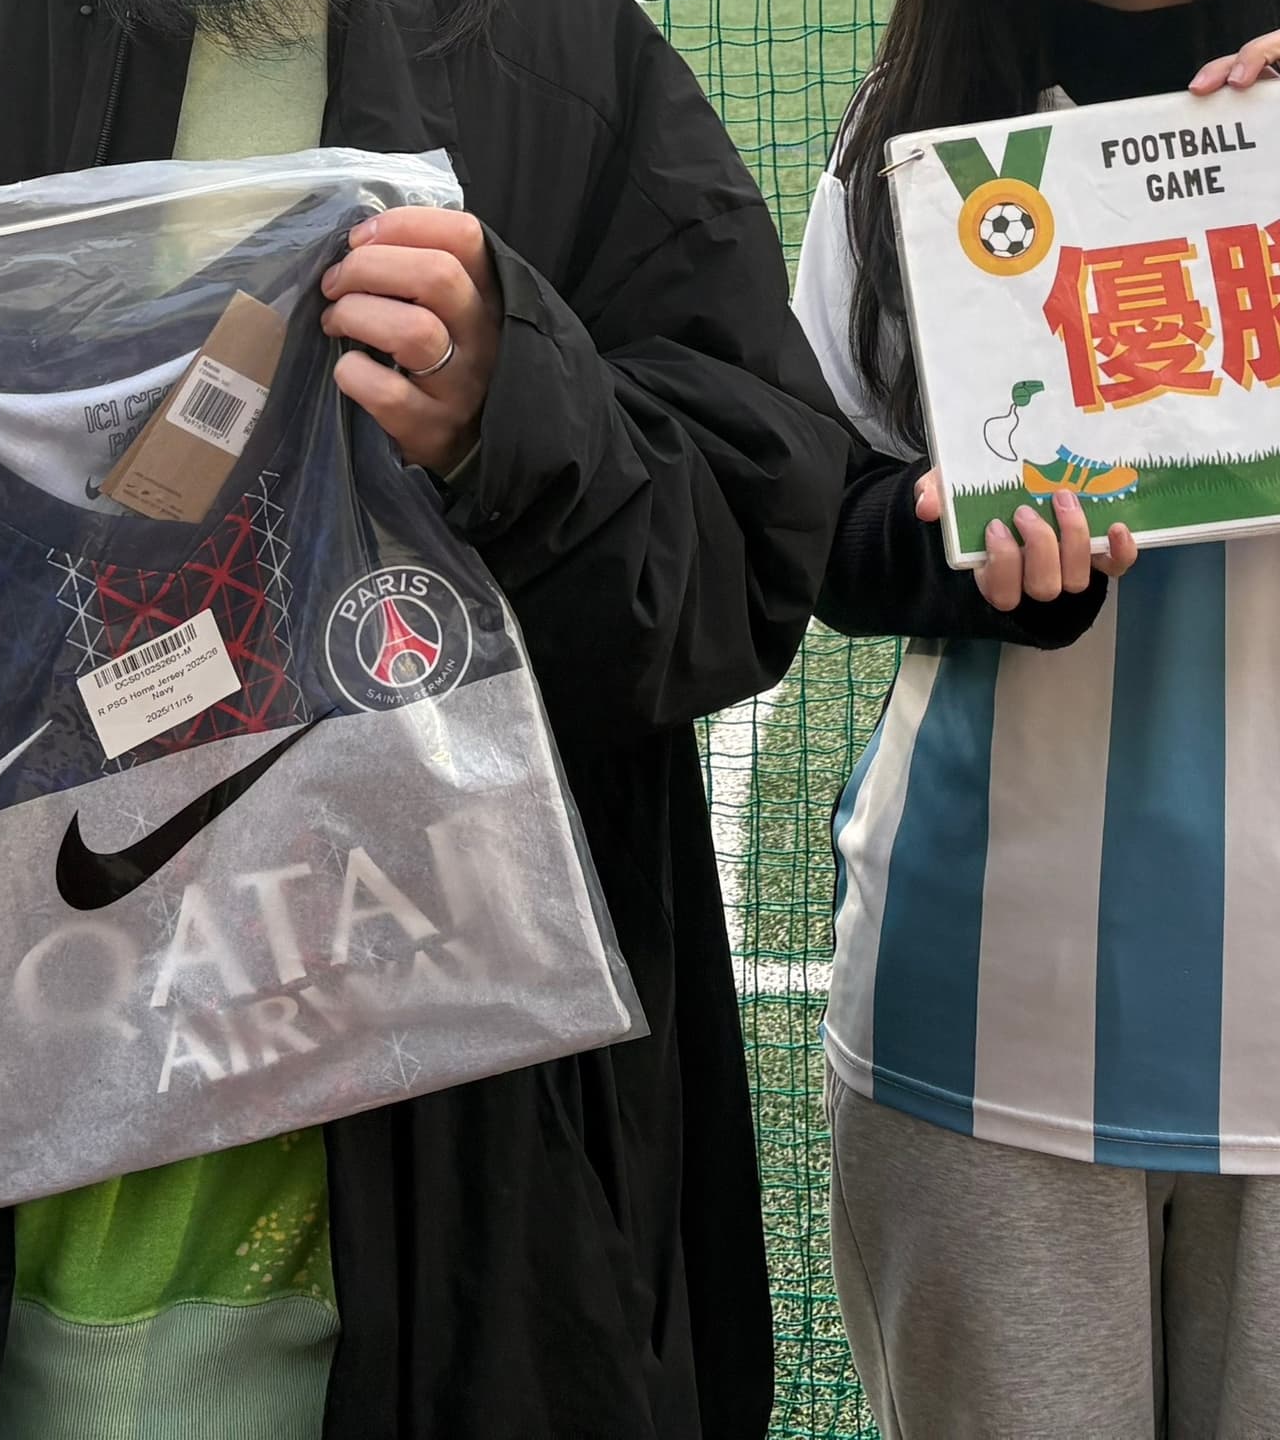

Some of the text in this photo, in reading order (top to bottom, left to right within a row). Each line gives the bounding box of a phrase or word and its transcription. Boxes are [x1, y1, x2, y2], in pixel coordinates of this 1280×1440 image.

[1101, 122, 1256, 168] FOOTBALL
[1146, 165, 1225, 202] GAME
[339, 573, 430, 622] PARIS
[97, 708, 106, 717] R
[107, 698, 128, 713] PSG
[129, 684, 156, 701] Home
[157, 668, 185, 689] Jersey
[145, 693, 195, 723] 2025/11/15
[152, 684, 175, 701] Navy
